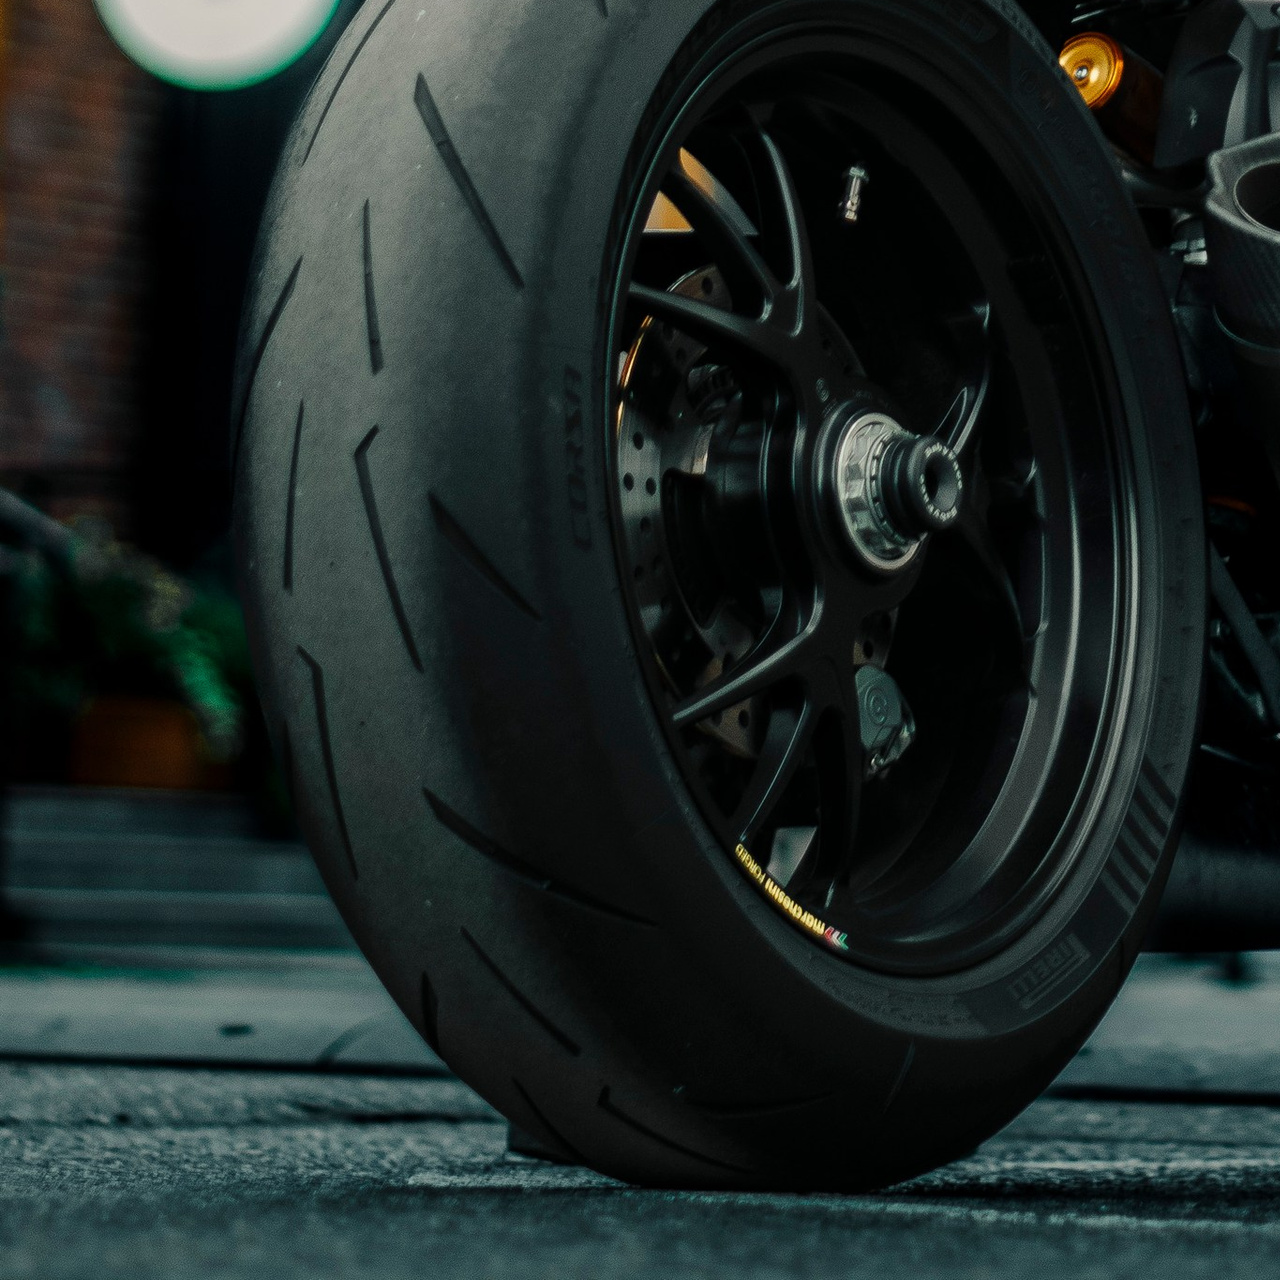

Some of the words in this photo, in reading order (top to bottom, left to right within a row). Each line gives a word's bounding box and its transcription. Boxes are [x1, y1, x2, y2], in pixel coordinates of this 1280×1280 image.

[562, 363, 593, 554] CORSA
[735, 843, 767, 884] FORGED
[1008, 933, 1091, 1011] PIRELLI
